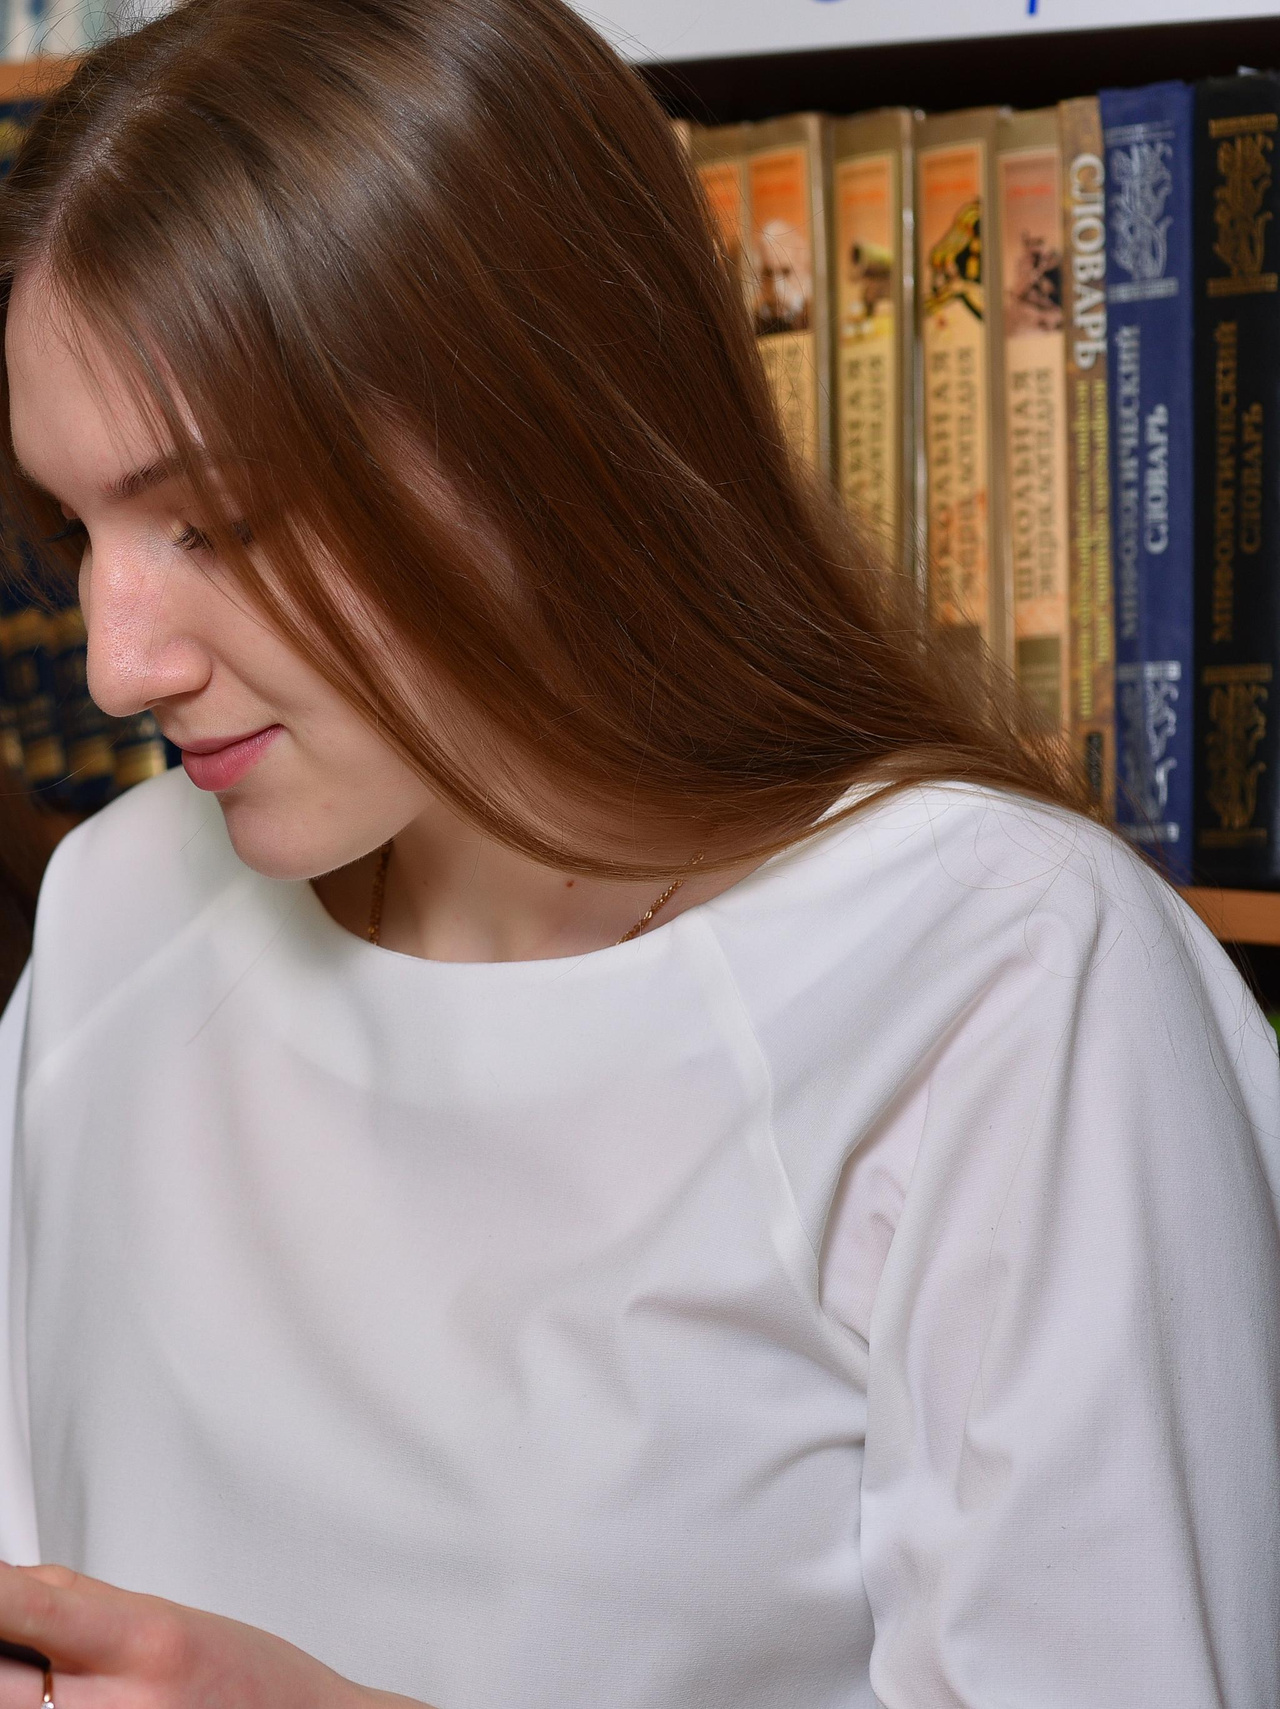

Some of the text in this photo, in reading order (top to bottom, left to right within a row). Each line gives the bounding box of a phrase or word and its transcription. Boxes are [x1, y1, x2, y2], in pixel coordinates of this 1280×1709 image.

[1070, 152, 1108, 372] СЛОВАРЬ
[1012, 371, 1034, 603] ШКОЛЬНАЯ
[1035, 367, 1055, 595] ЭНЦИКЛОПЕДИЯ
[1116, 324, 1141, 640] МИФОЛОГИЧЕСКИЙ
[1144, 403, 1169, 555] СЛОВАРЬ
[1213, 321, 1239, 642] МИФОЛОГИЧЕСКИЙ
[1240, 403, 1264, 554] СЛОВАРЬ
